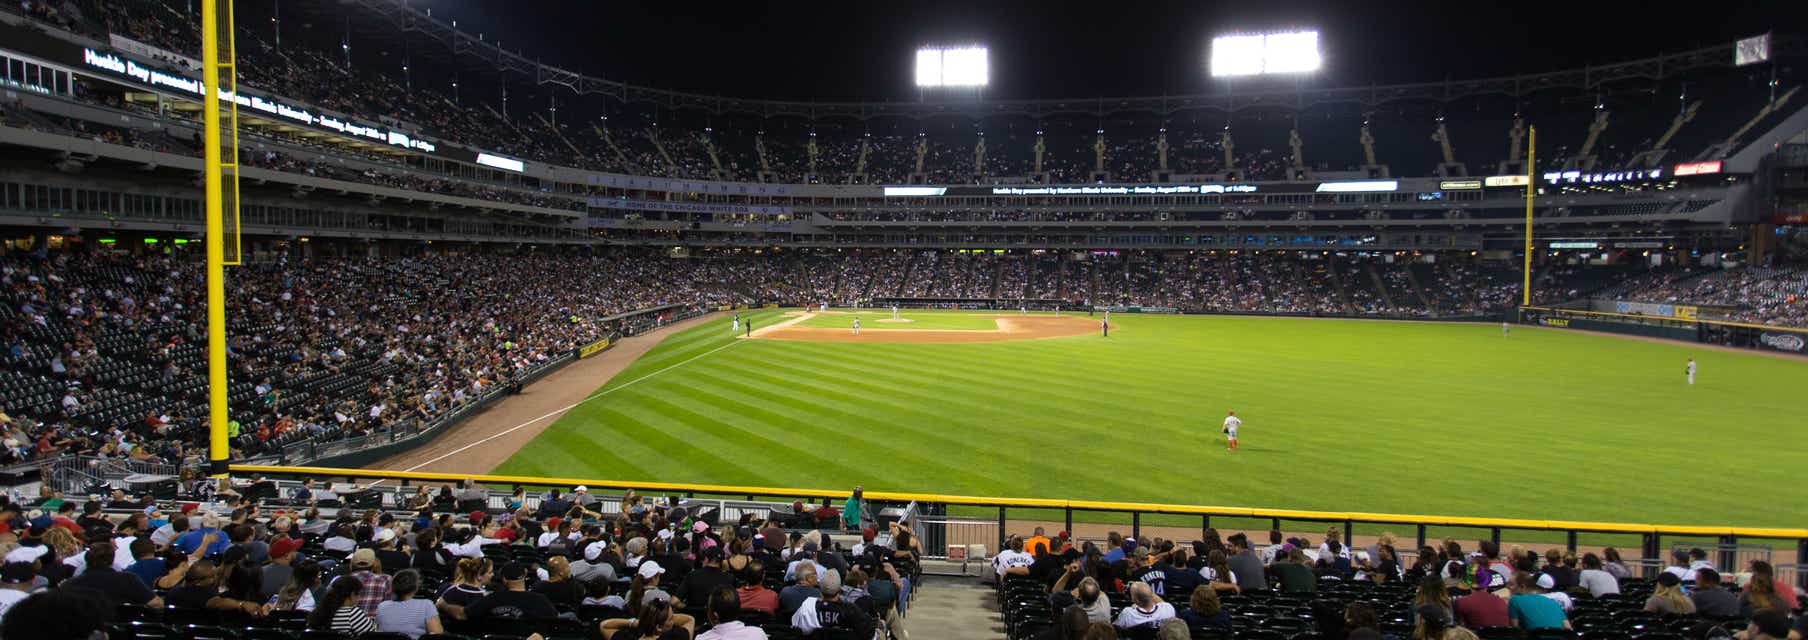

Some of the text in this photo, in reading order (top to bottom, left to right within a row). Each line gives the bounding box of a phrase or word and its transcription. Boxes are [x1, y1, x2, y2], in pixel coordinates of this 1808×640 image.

[84, 47, 126, 74] Huskie
[126, 60, 149, 82] Day
[150, 70, 199, 93] presented
[1012, 187, 1023, 195] Day
[1151, 580, 1165, 595] 14
[819, 611, 840, 625] ISK
